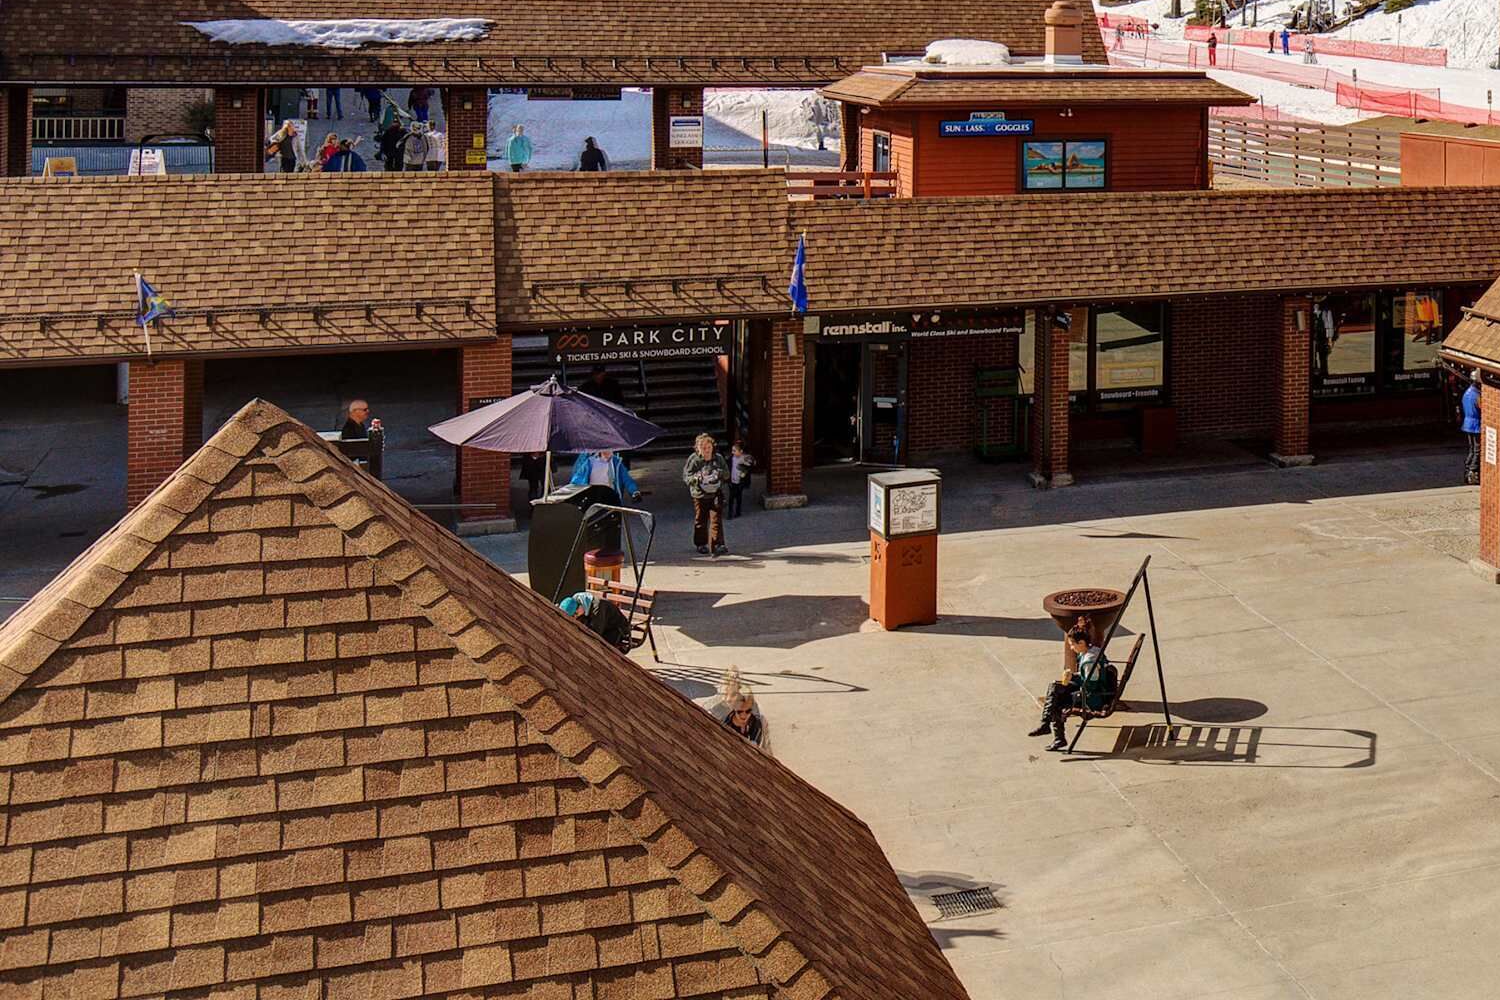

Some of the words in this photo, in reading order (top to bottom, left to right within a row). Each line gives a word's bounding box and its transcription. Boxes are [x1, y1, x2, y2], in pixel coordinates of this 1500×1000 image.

[995, 124, 1030, 132] GOGGLES
[602, 329, 661, 346] PARK
[672, 326, 724, 343] CITY
[823, 321, 891, 336] rennstall
[892, 323, 907, 333] inc.
[969, 327, 1001, 335] Snowboard
[567, 352, 600, 361] TICKETS
[600, 351, 618, 360] AND
[619, 351, 631, 359] SKI
[632, 350, 639, 358] &
[640, 348, 692, 358] SNOWBOARD
[692, 346, 725, 355] SCHOOL
